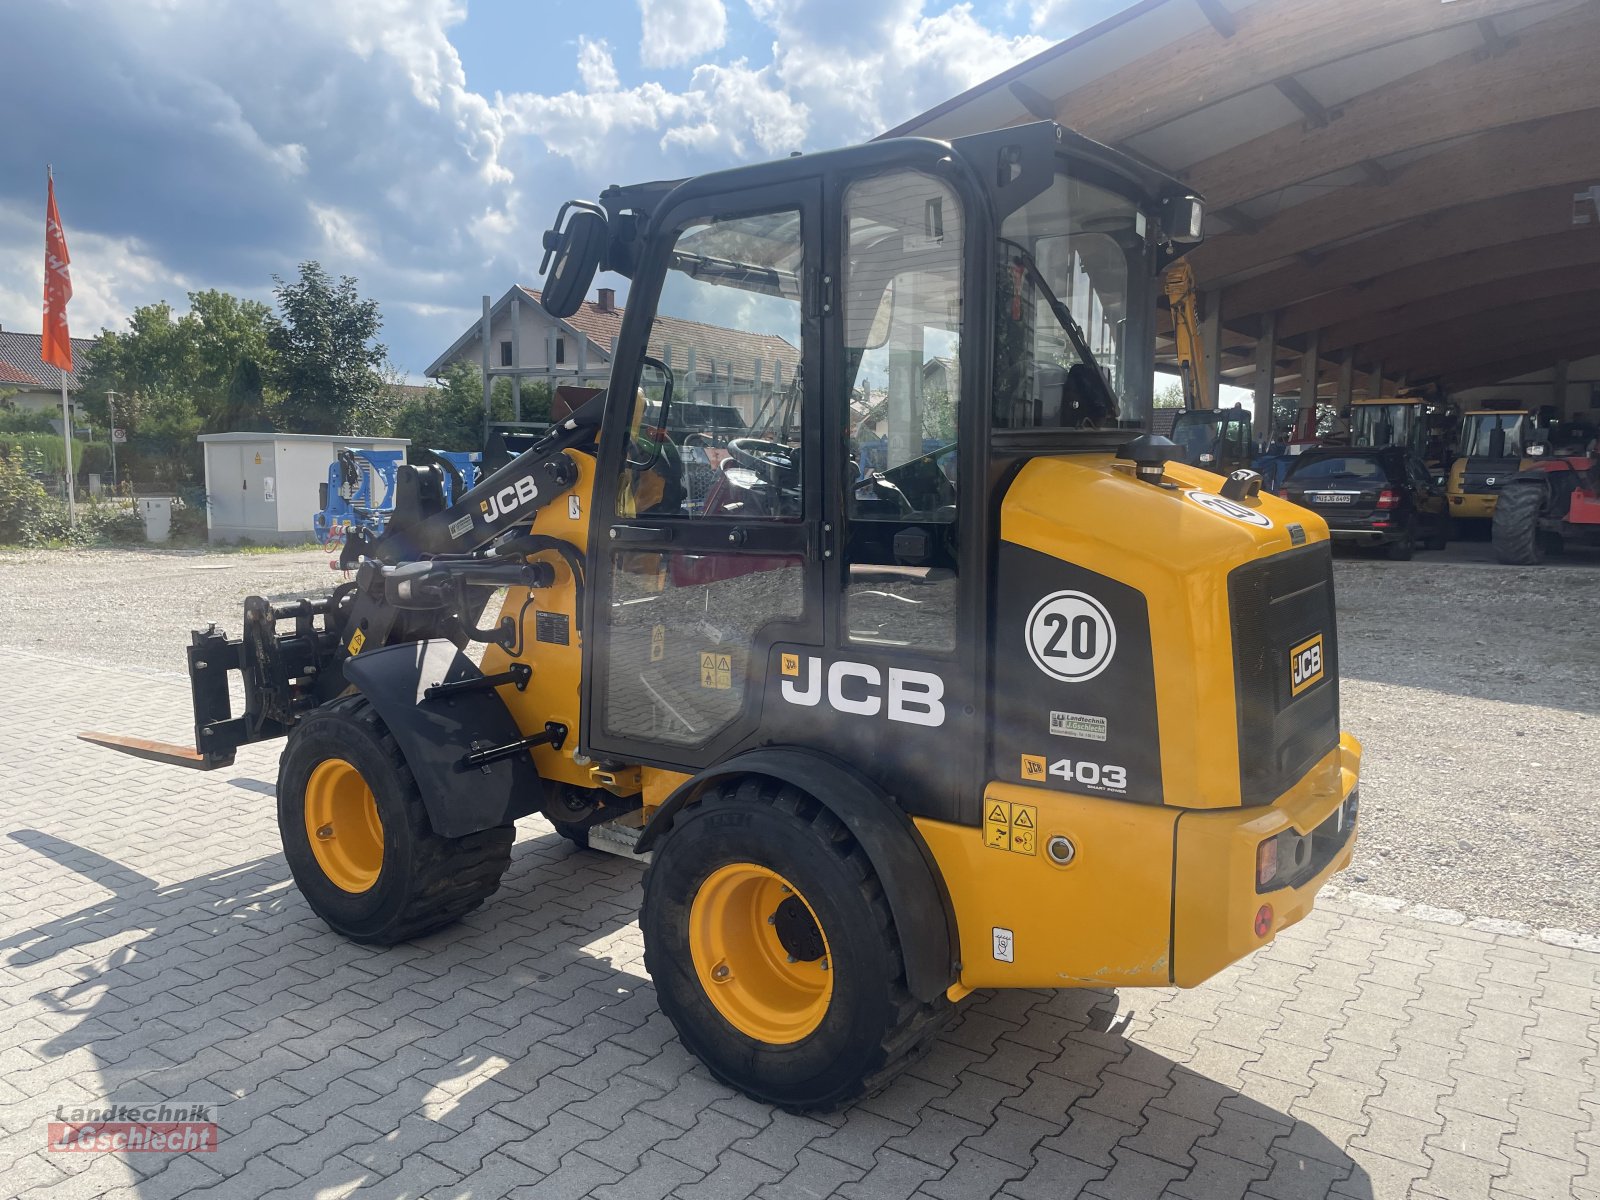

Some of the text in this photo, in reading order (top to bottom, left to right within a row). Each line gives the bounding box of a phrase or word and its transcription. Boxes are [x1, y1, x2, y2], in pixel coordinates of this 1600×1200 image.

[484, 475, 538, 523] JCB
[1043, 612, 1097, 660] 20
[1294, 644, 1321, 685] JCB
[781, 656, 946, 727] JCB
[1066, 714, 1105, 725] Landtechnik
[1066, 722, 1105, 733] J.Gschlecht
[1048, 758, 1127, 789] 403
